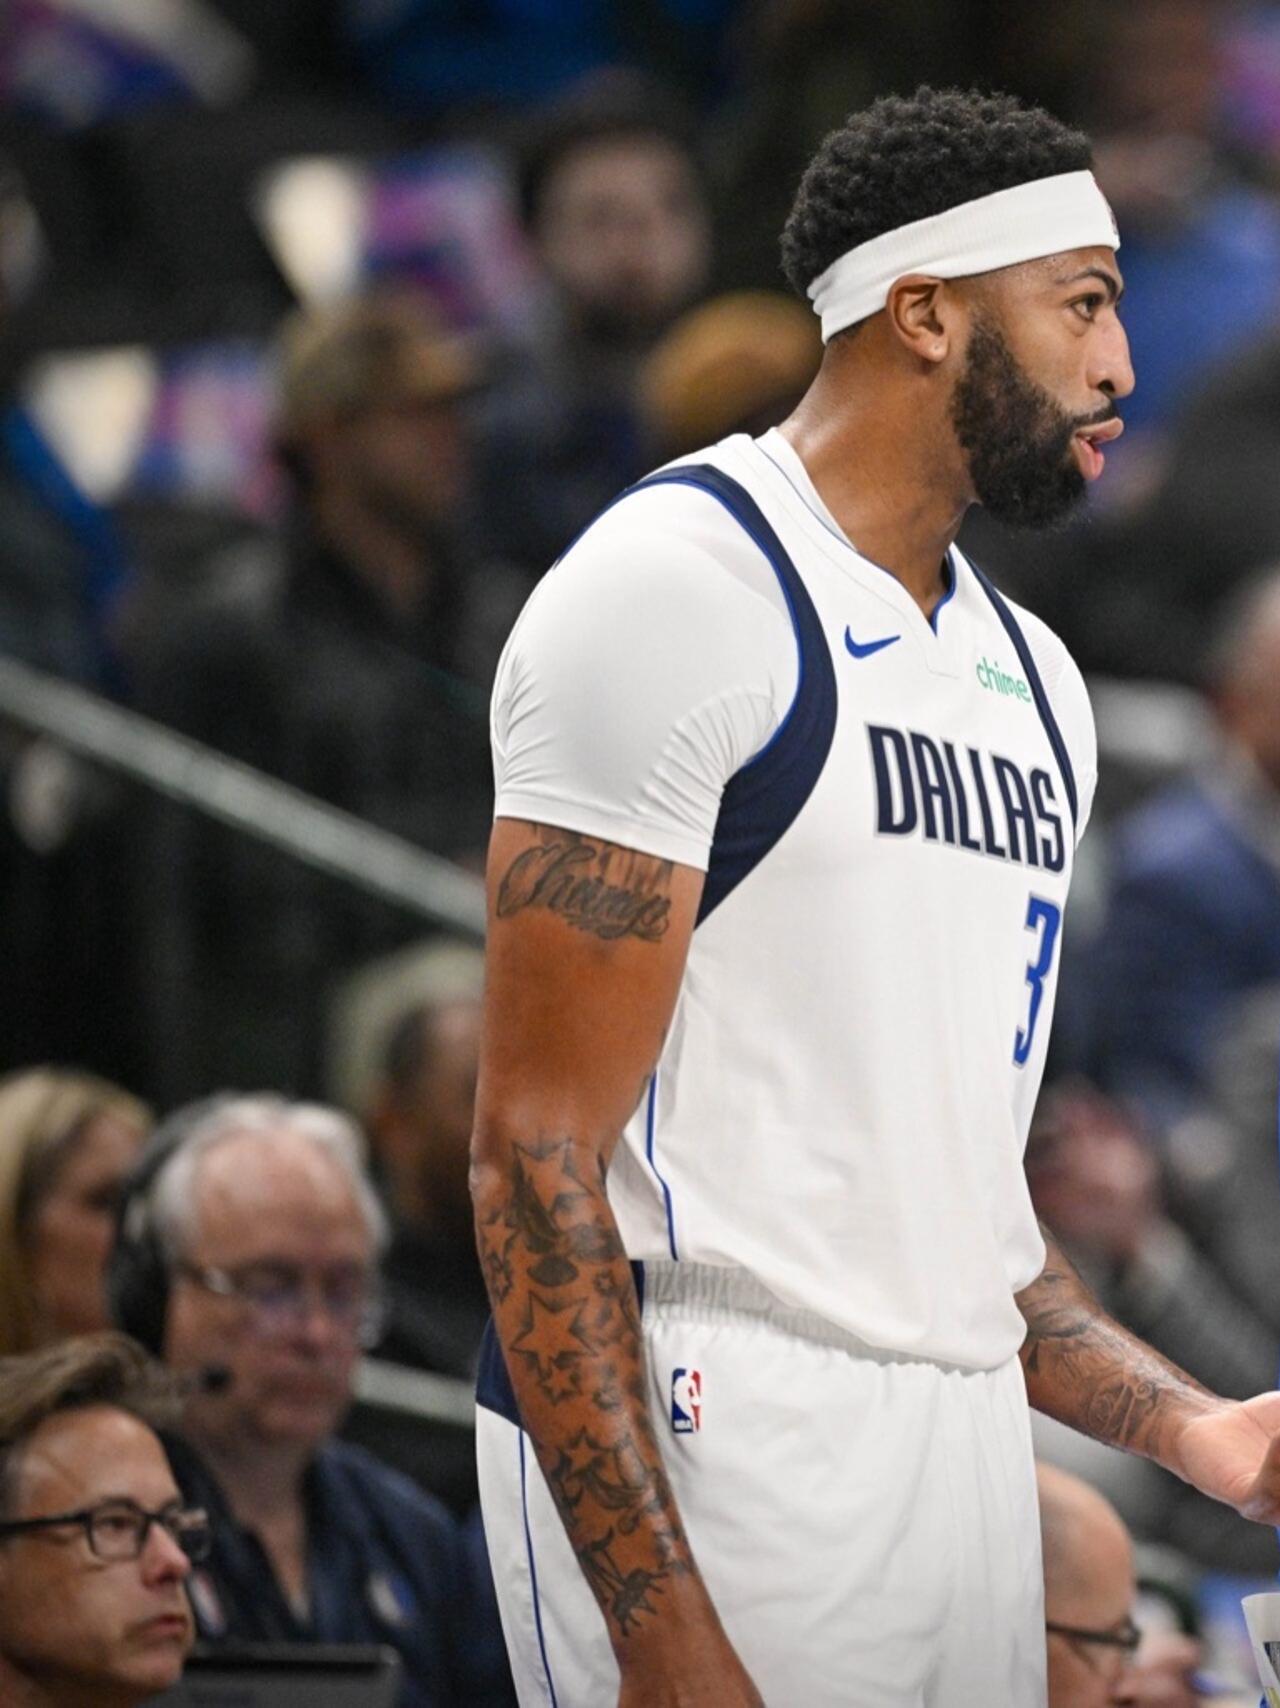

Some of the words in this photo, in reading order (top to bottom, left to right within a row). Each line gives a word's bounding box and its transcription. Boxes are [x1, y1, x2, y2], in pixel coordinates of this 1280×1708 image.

[976, 656, 1031, 703] chime
[866, 722, 1065, 875] DALLAS
[1012, 891, 1061, 1069] 3
